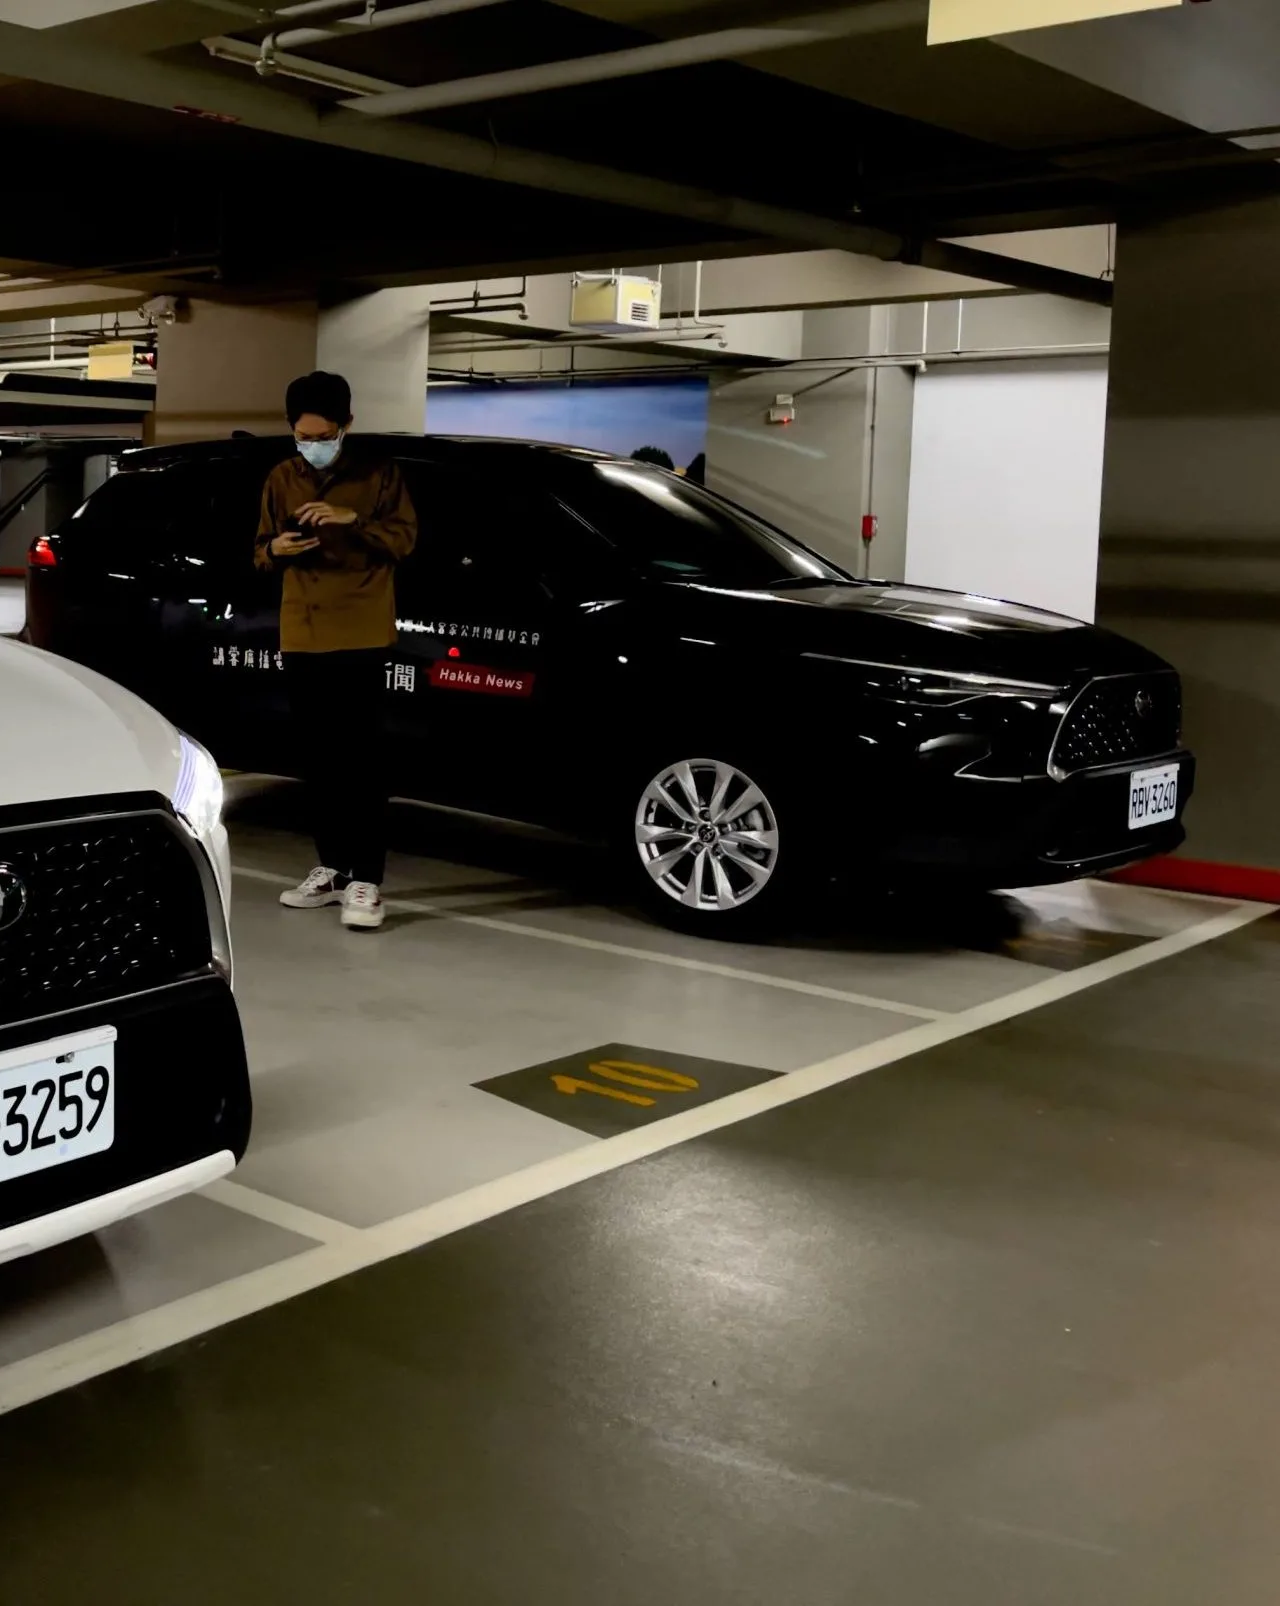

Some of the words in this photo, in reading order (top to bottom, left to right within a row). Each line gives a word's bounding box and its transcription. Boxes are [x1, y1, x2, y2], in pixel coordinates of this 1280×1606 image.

[439, 667, 480, 684] Hakka
[485, 673, 523, 690] News
[552, 1060, 699, 1107] 10
